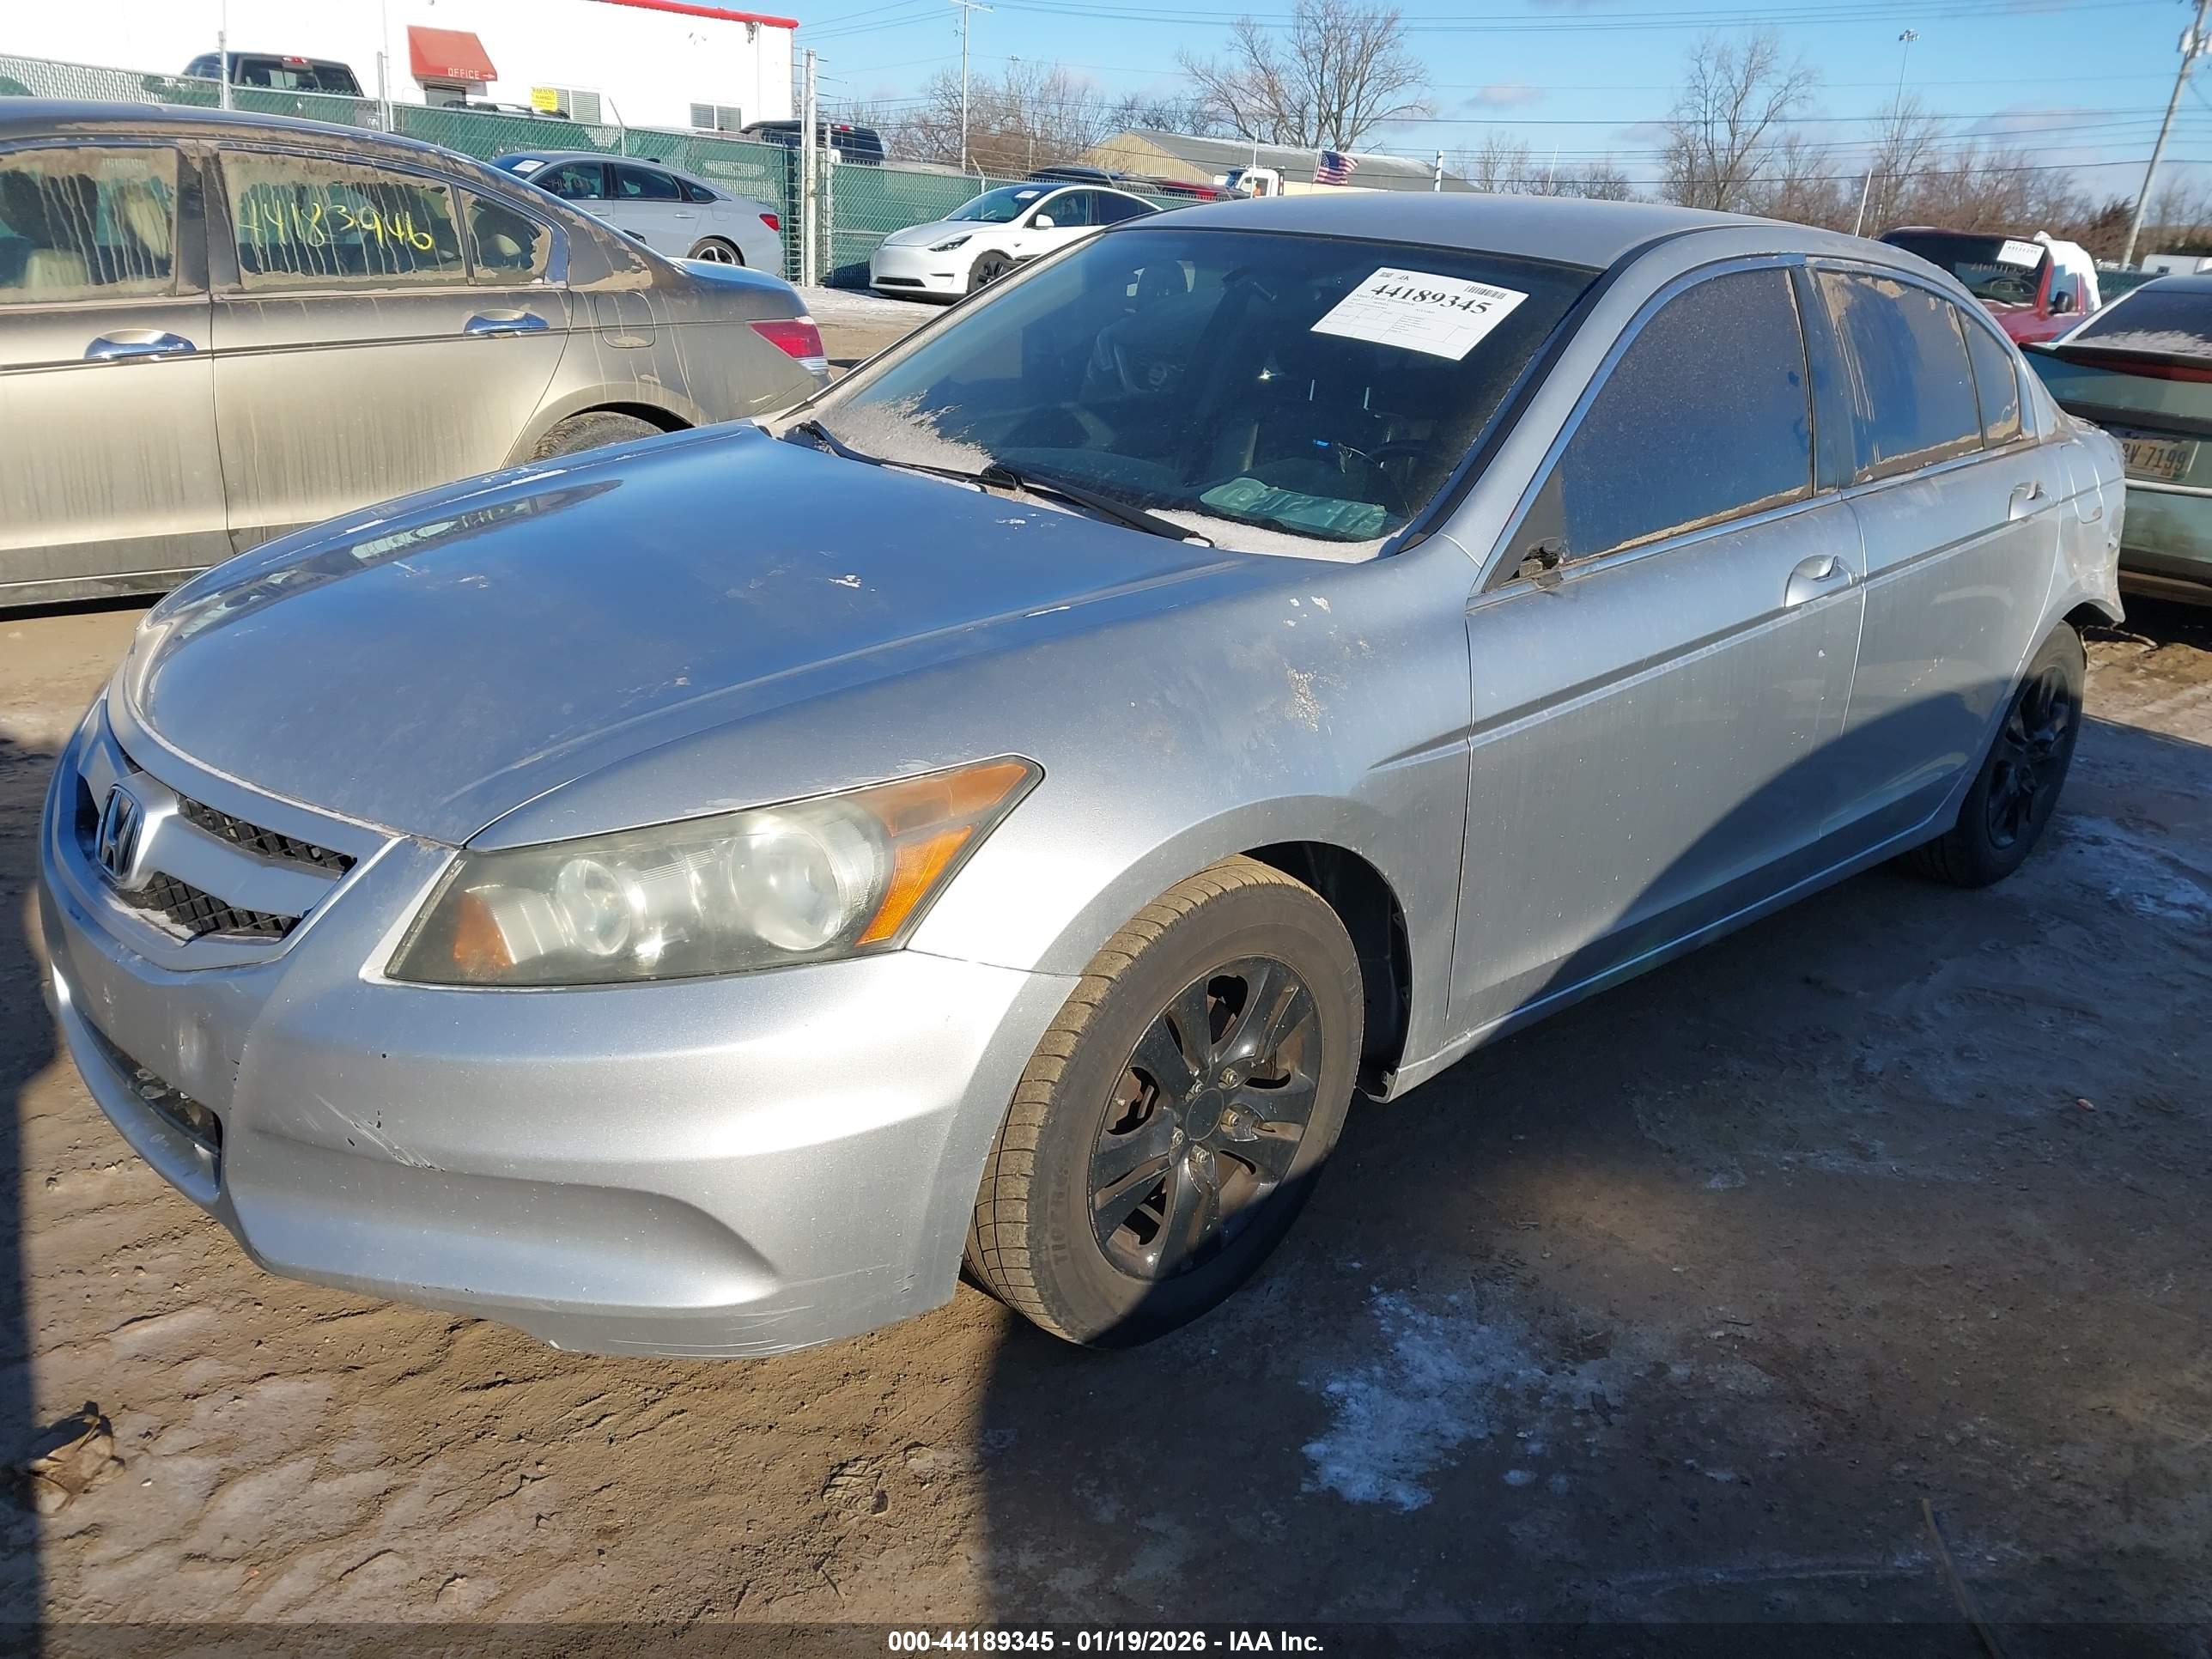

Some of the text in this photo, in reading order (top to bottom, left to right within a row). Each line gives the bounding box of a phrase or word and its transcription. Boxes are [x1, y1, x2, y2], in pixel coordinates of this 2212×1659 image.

[447, 67, 480, 80] OFFICE
[237, 198, 434, 251] 44183946
[1370, 283, 1493, 314] 44189345
[2144, 446, 2186, 471] 7199
